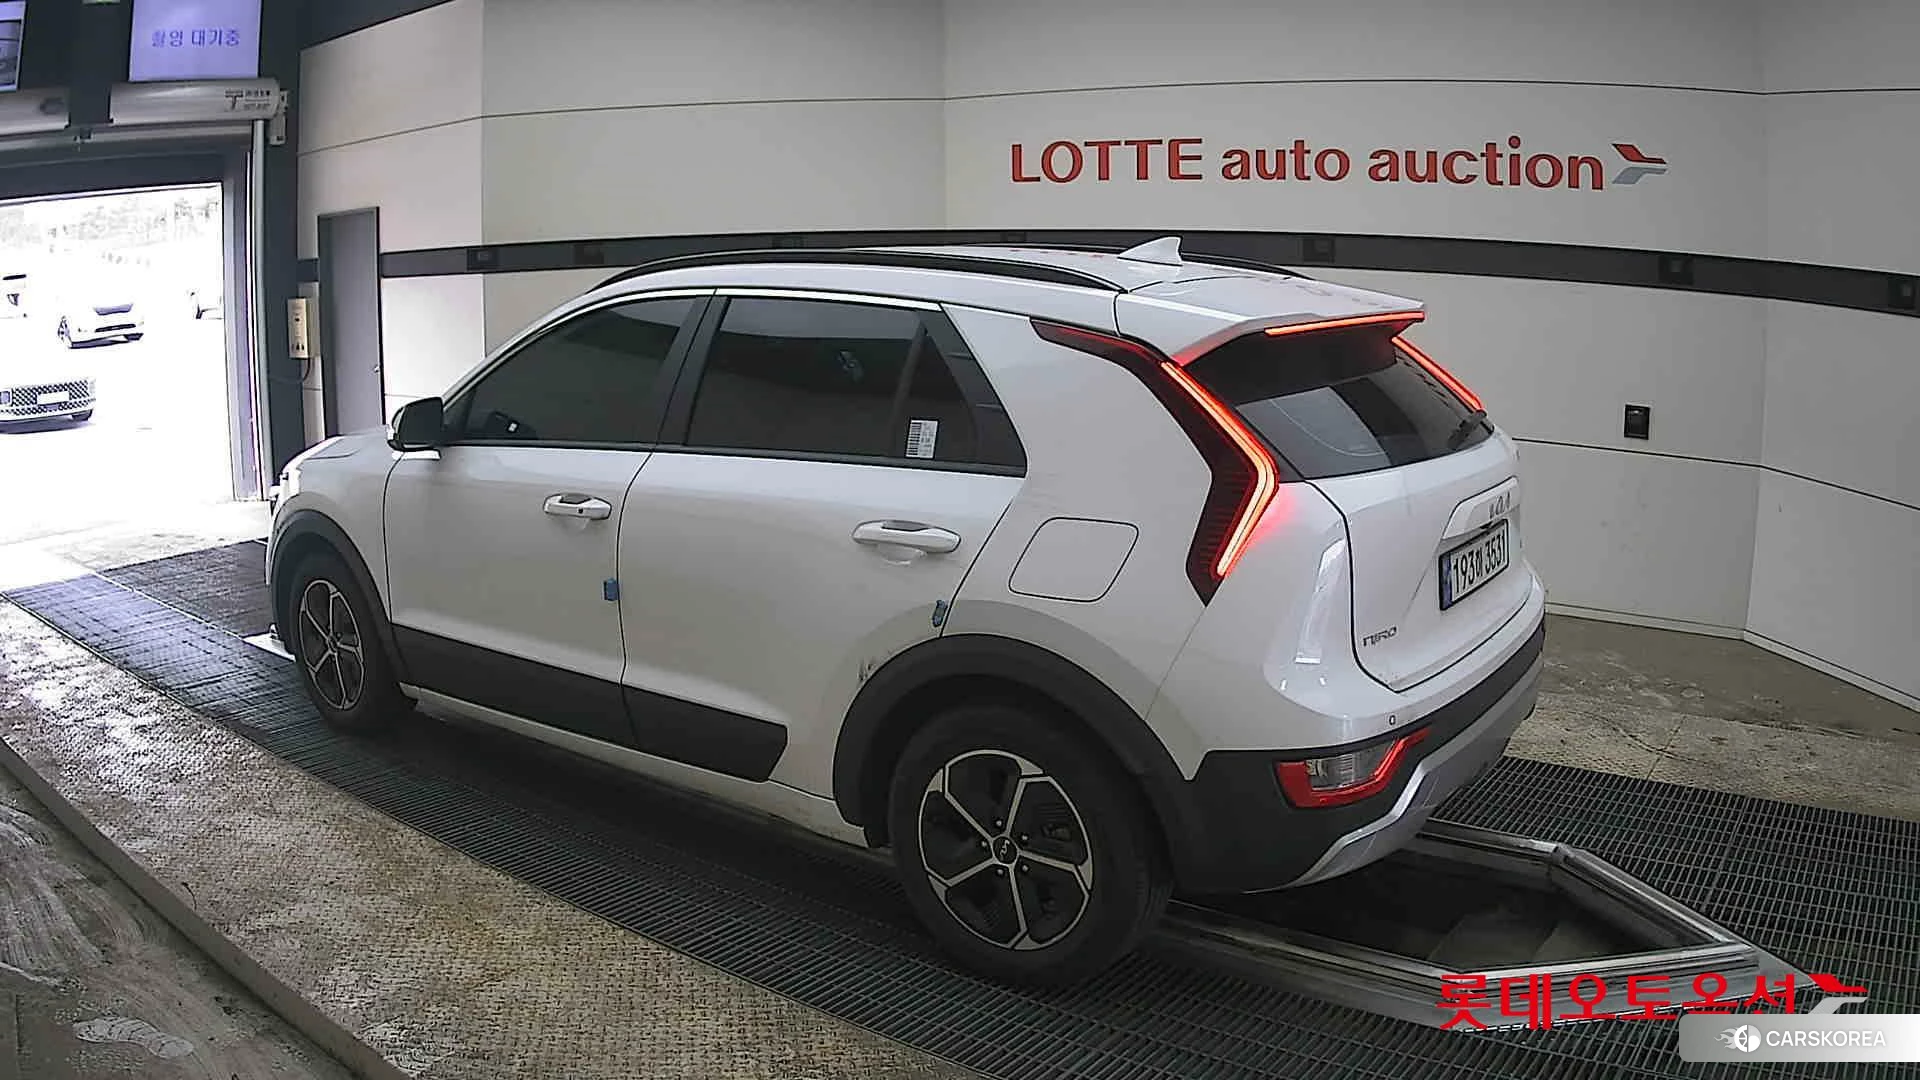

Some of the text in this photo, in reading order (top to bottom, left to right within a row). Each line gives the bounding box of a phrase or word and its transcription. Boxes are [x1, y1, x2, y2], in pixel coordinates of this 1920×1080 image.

[192, 28, 241, 47] 대기중
[1011, 135, 1605, 190] LOTTE auto auction
